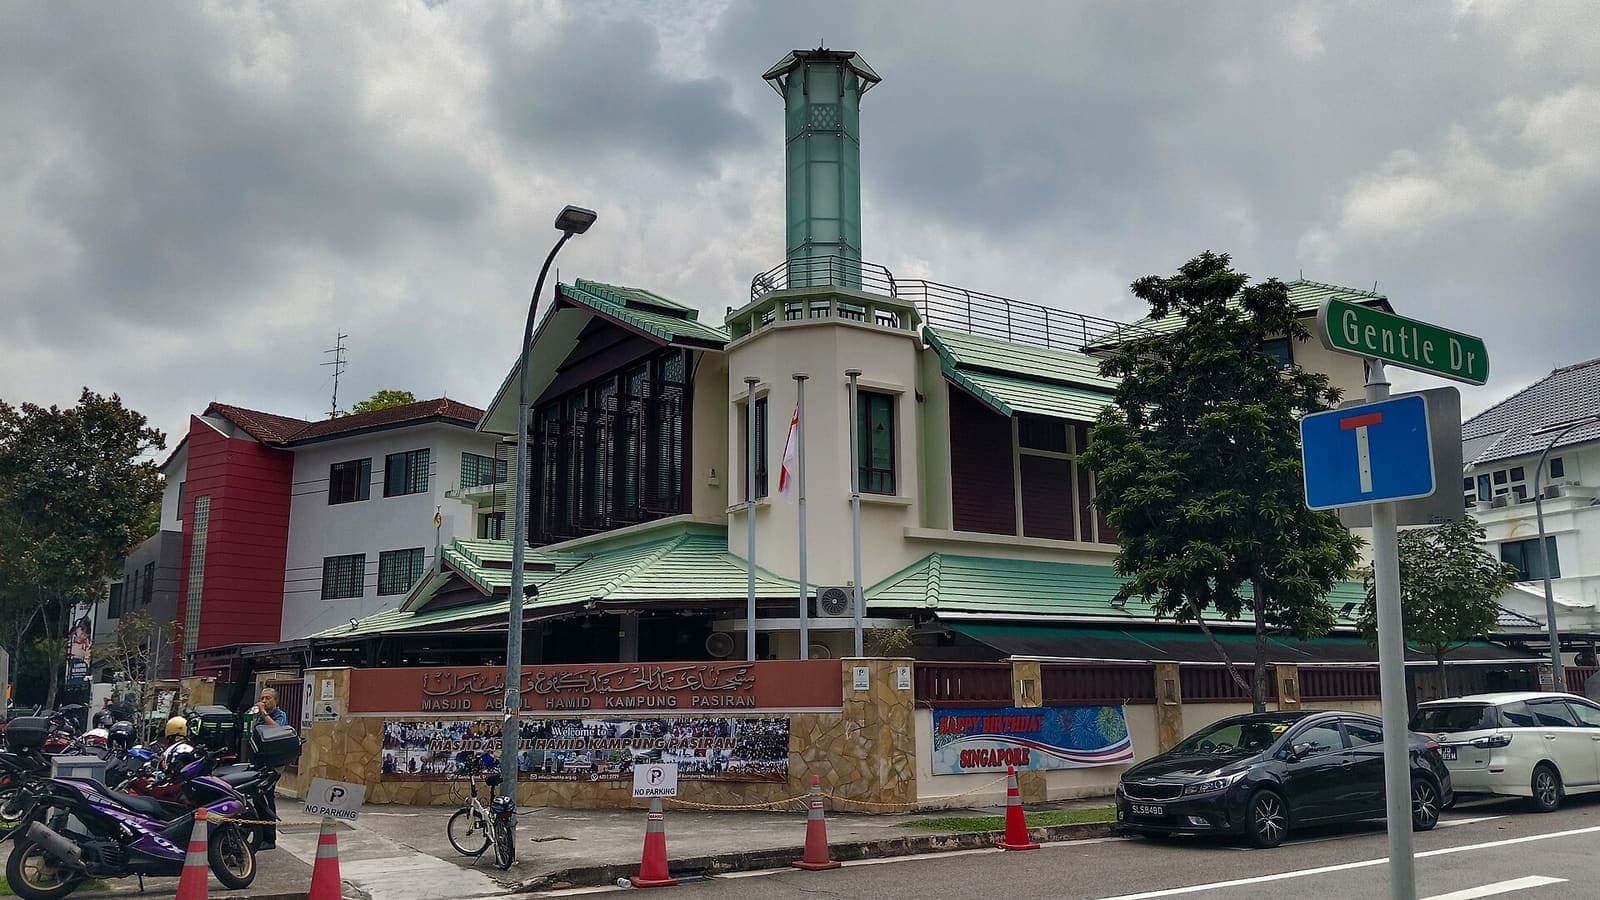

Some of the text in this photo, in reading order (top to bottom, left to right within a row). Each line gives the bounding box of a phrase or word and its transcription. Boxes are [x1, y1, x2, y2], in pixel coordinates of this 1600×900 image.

[1342, 309, 1475, 374] Gentle Dr
[422, 694, 756, 710] MASJID ABL HAMID KAMPUNG PASIRAN
[551, 725, 608, 737] Welcome to
[939, 714, 1045, 734] HAPPY BIRTHDAY
[430, 738, 482, 751] MASJID
[534, 738, 586, 751] HAMID
[588, 737, 666, 751] KAMPUNG
[668, 737, 738, 750] PASIRAN
[960, 747, 1030, 768] SINGAPORE
[634, 786, 676, 796] NO PARKING
[305, 804, 357, 819] NO PARKING
